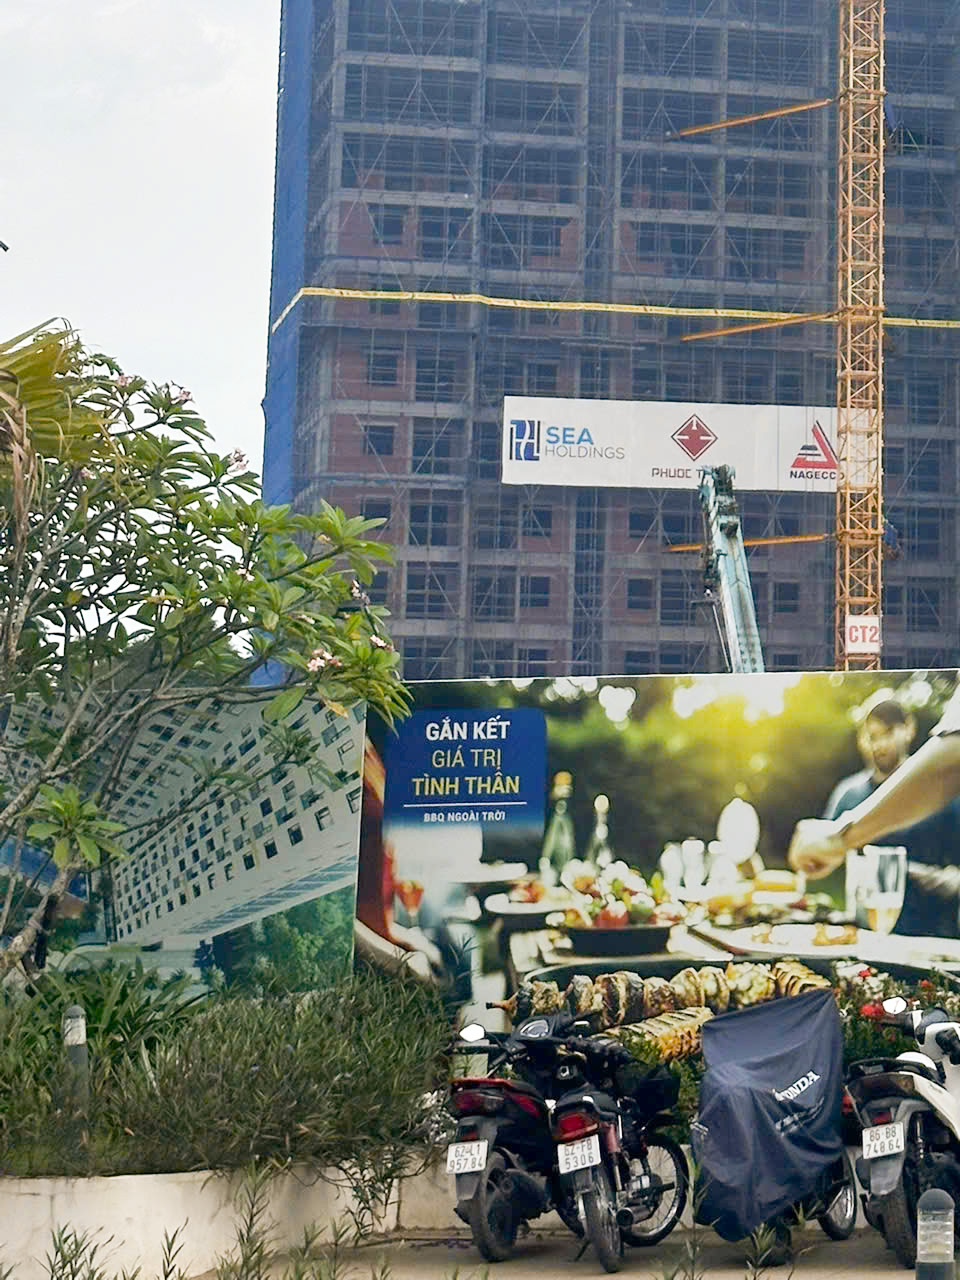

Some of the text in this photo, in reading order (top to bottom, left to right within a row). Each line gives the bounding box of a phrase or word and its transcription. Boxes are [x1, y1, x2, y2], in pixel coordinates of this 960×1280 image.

[546, 427, 594, 446] SEA
[544, 445, 625, 460] HOLDINGS
[849, 625, 879, 643] CT2
[425, 715, 511, 741] GẮN KẾT
[432, 745, 465, 768] GIÁ
[412, 771, 520, 796] TÌNH THÂN
[423, 810, 506, 823] BBQ NGOÀI TRỜI
[565, 1152, 594, 1170] 5306
